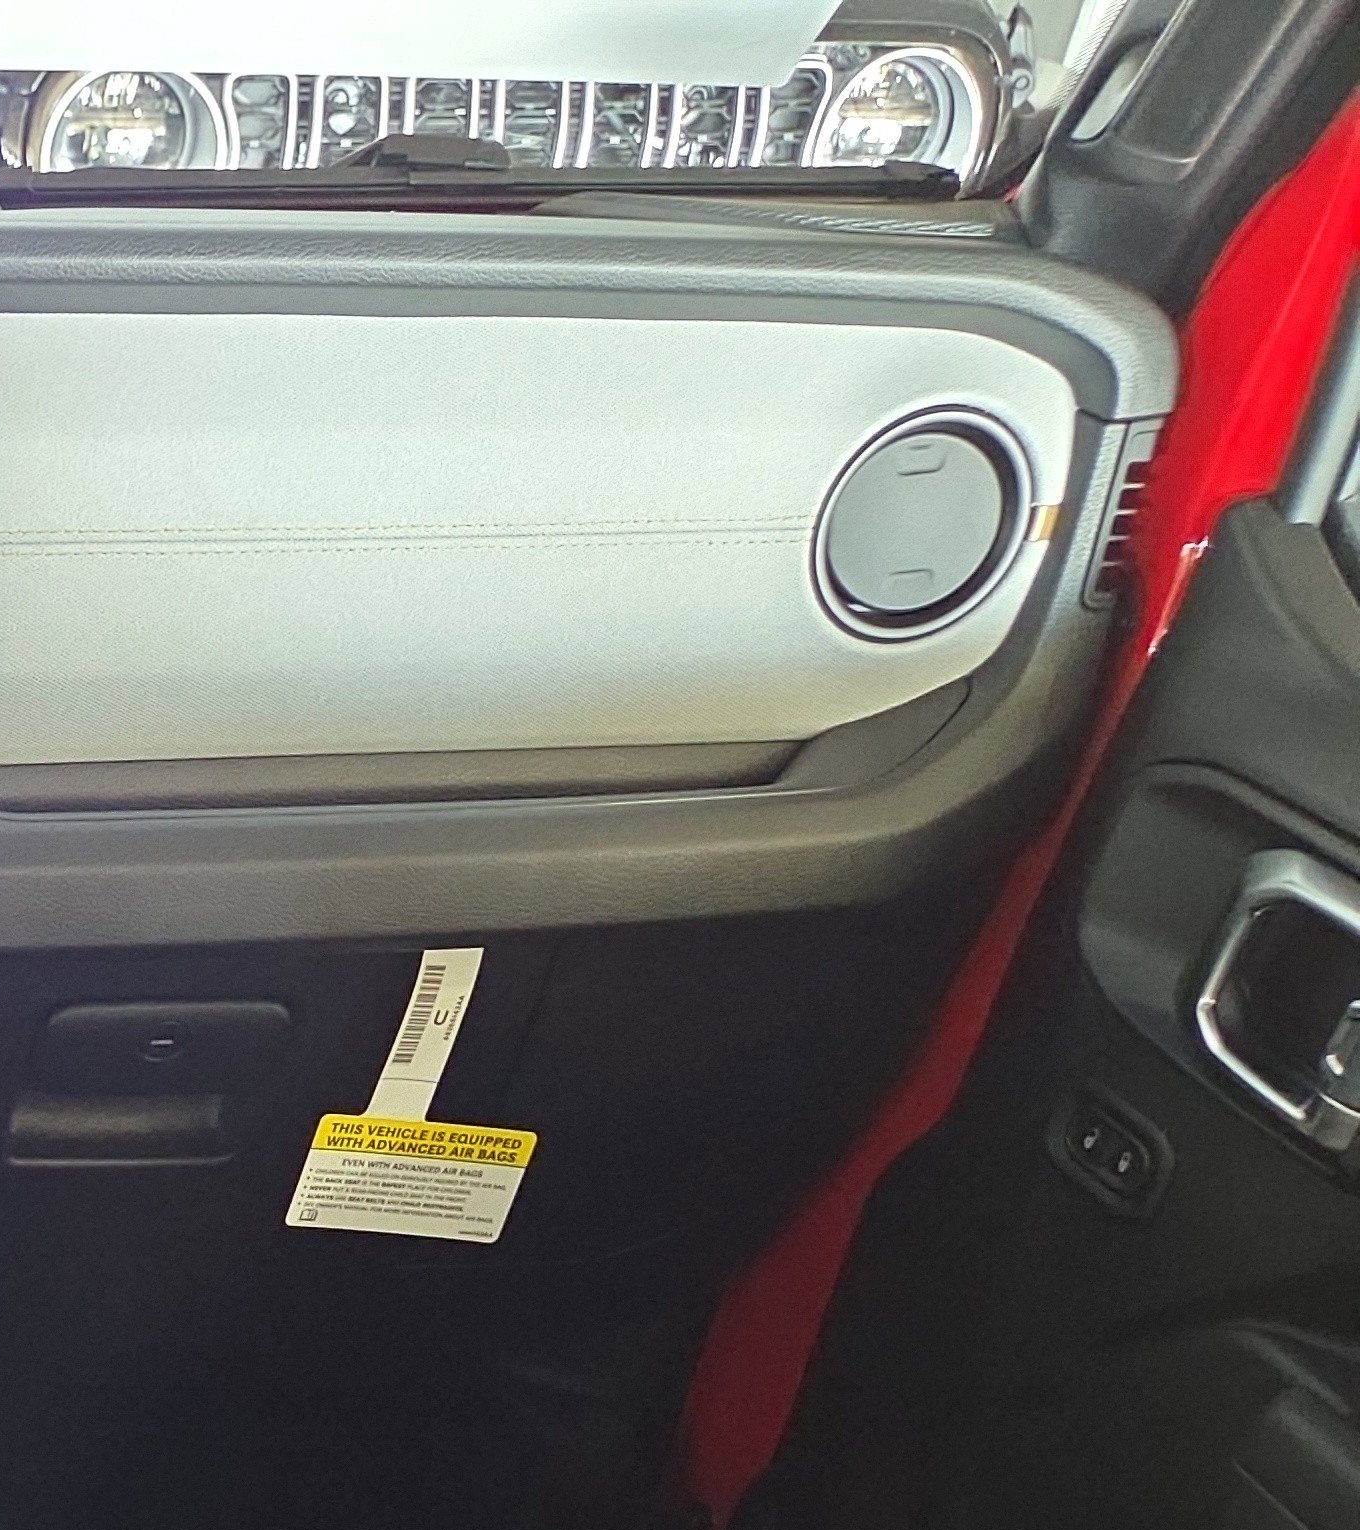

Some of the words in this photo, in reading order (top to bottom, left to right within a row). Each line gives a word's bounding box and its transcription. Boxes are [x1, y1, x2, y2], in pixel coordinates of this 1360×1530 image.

[433, 1009, 449, 1026] U
[331, 1122, 363, 1136] THIS
[367, 1125, 429, 1141] VEHICLE
[431, 1131, 446, 1142] IS
[448, 1133, 523, 1150] EQUIPPED
[327, 1135, 363, 1149] WITH
[367, 1139, 447, 1156] ADVANCED
[450, 1146, 475, 1159] AIR
[477, 1150, 518, 1163] BAGS
[341, 1158, 366, 1168] EVEN
[367, 1160, 391, 1170] WITH
[392, 1162, 442, 1175] ADVANCED
[441, 1167, 459, 1176] AIR
[459, 1168, 484, 1178] BAGS
